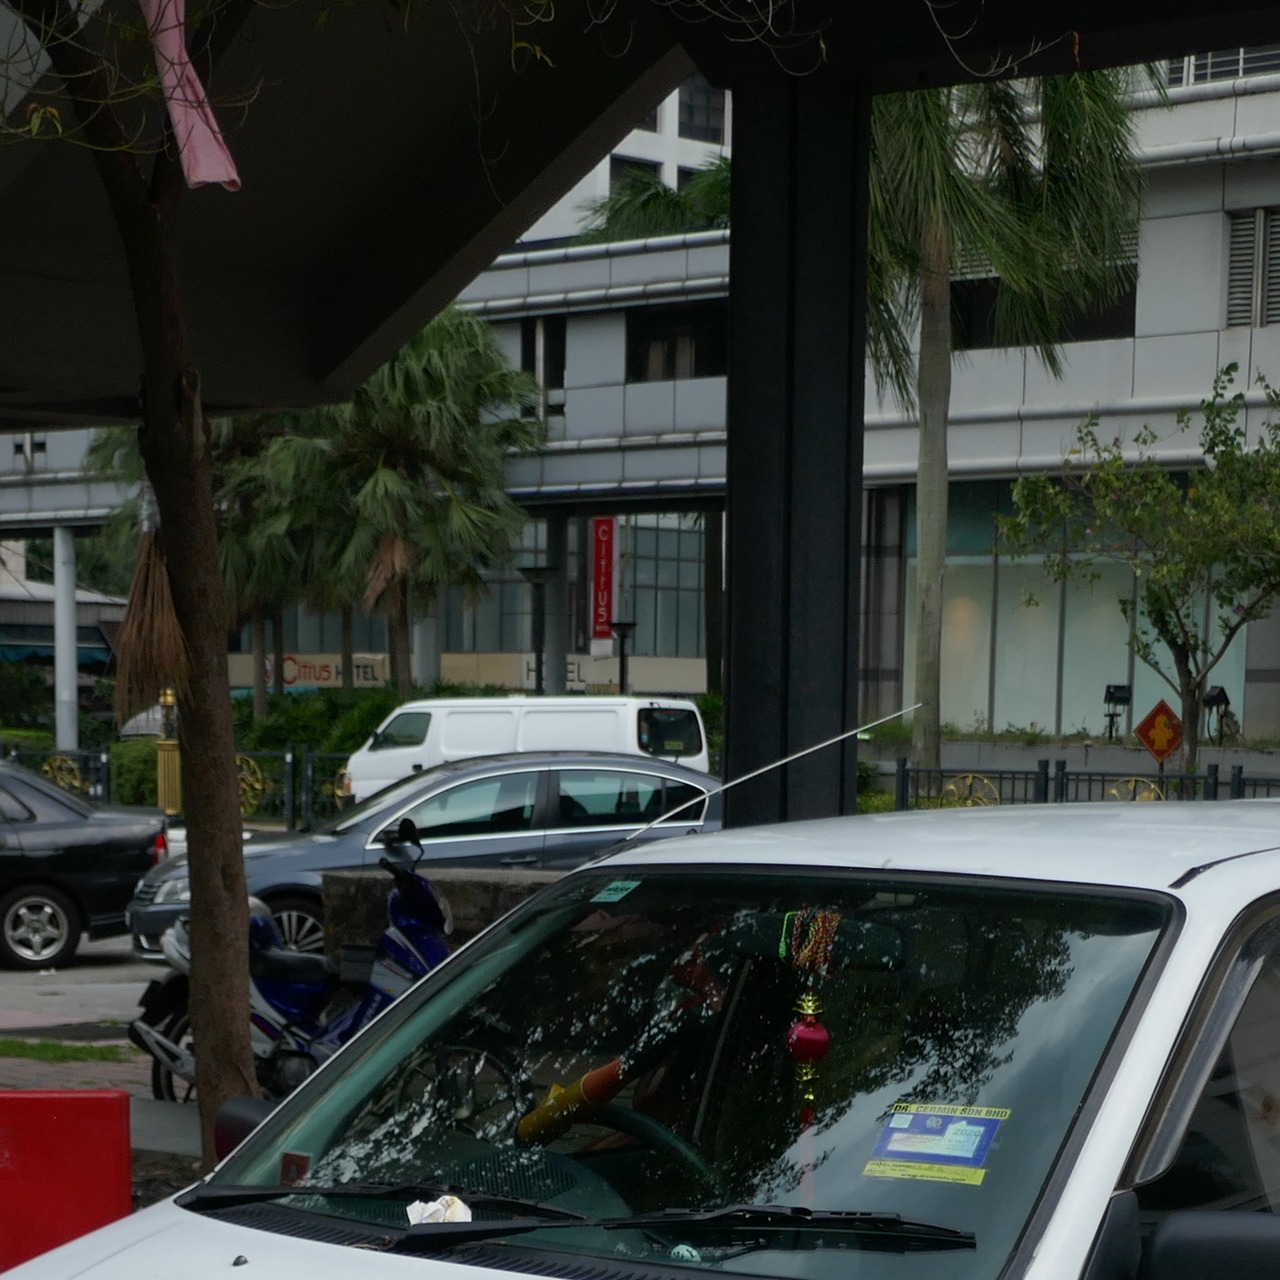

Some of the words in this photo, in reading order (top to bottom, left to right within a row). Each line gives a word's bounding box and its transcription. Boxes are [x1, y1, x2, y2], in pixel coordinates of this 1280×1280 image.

[335, 664, 378, 681] HTEL
[526, 661, 585, 683] HEL
[915, 1105, 958, 1115] CERMIN
[960, 1108, 982, 1116] SDN
[984, 1110, 1008, 1118] BHD
